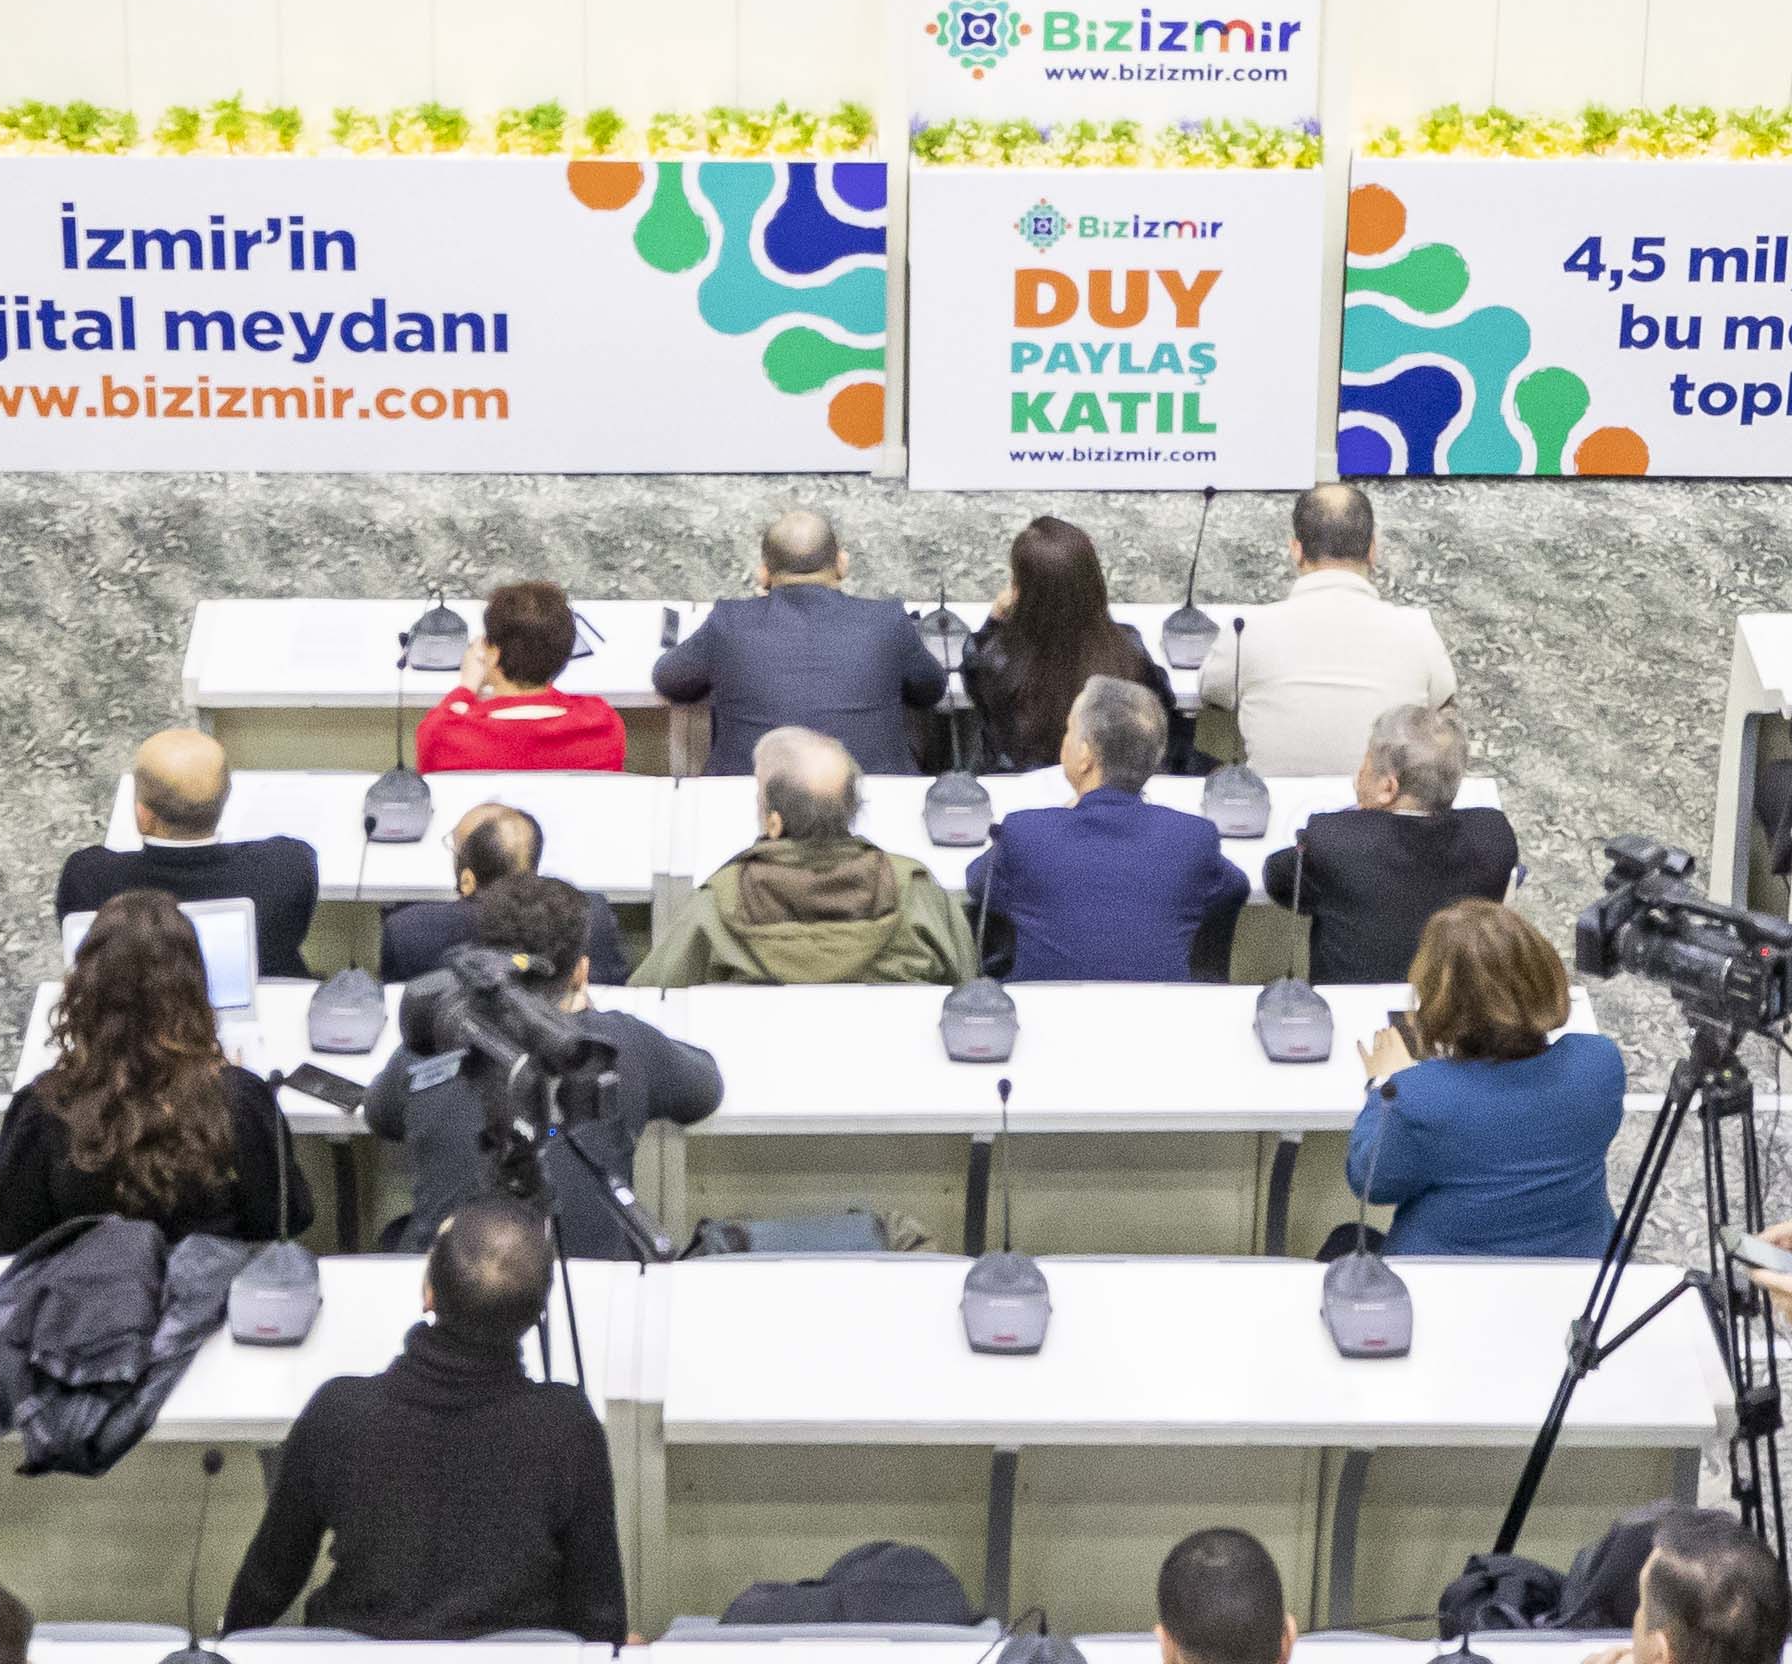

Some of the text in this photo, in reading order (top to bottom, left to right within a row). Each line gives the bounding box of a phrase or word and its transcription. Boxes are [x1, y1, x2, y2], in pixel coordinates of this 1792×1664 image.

[1042, 7, 1302, 54] Bizizmir
[1045, 63, 1288, 82] www.bizizmir.com
[1078, 214, 1224, 241] Bizizmir
[1563, 235, 1667, 291] 4,5
[1013, 267, 1223, 330] DUY
[164, 297, 509, 364] meydanı
[1618, 303, 1702, 350] bu
[1010, 341, 1218, 386] PAYLAŞ
[1010, 391, 1218, 435] KATIL
[1009, 446, 1217, 463] www.bizizmir.com
